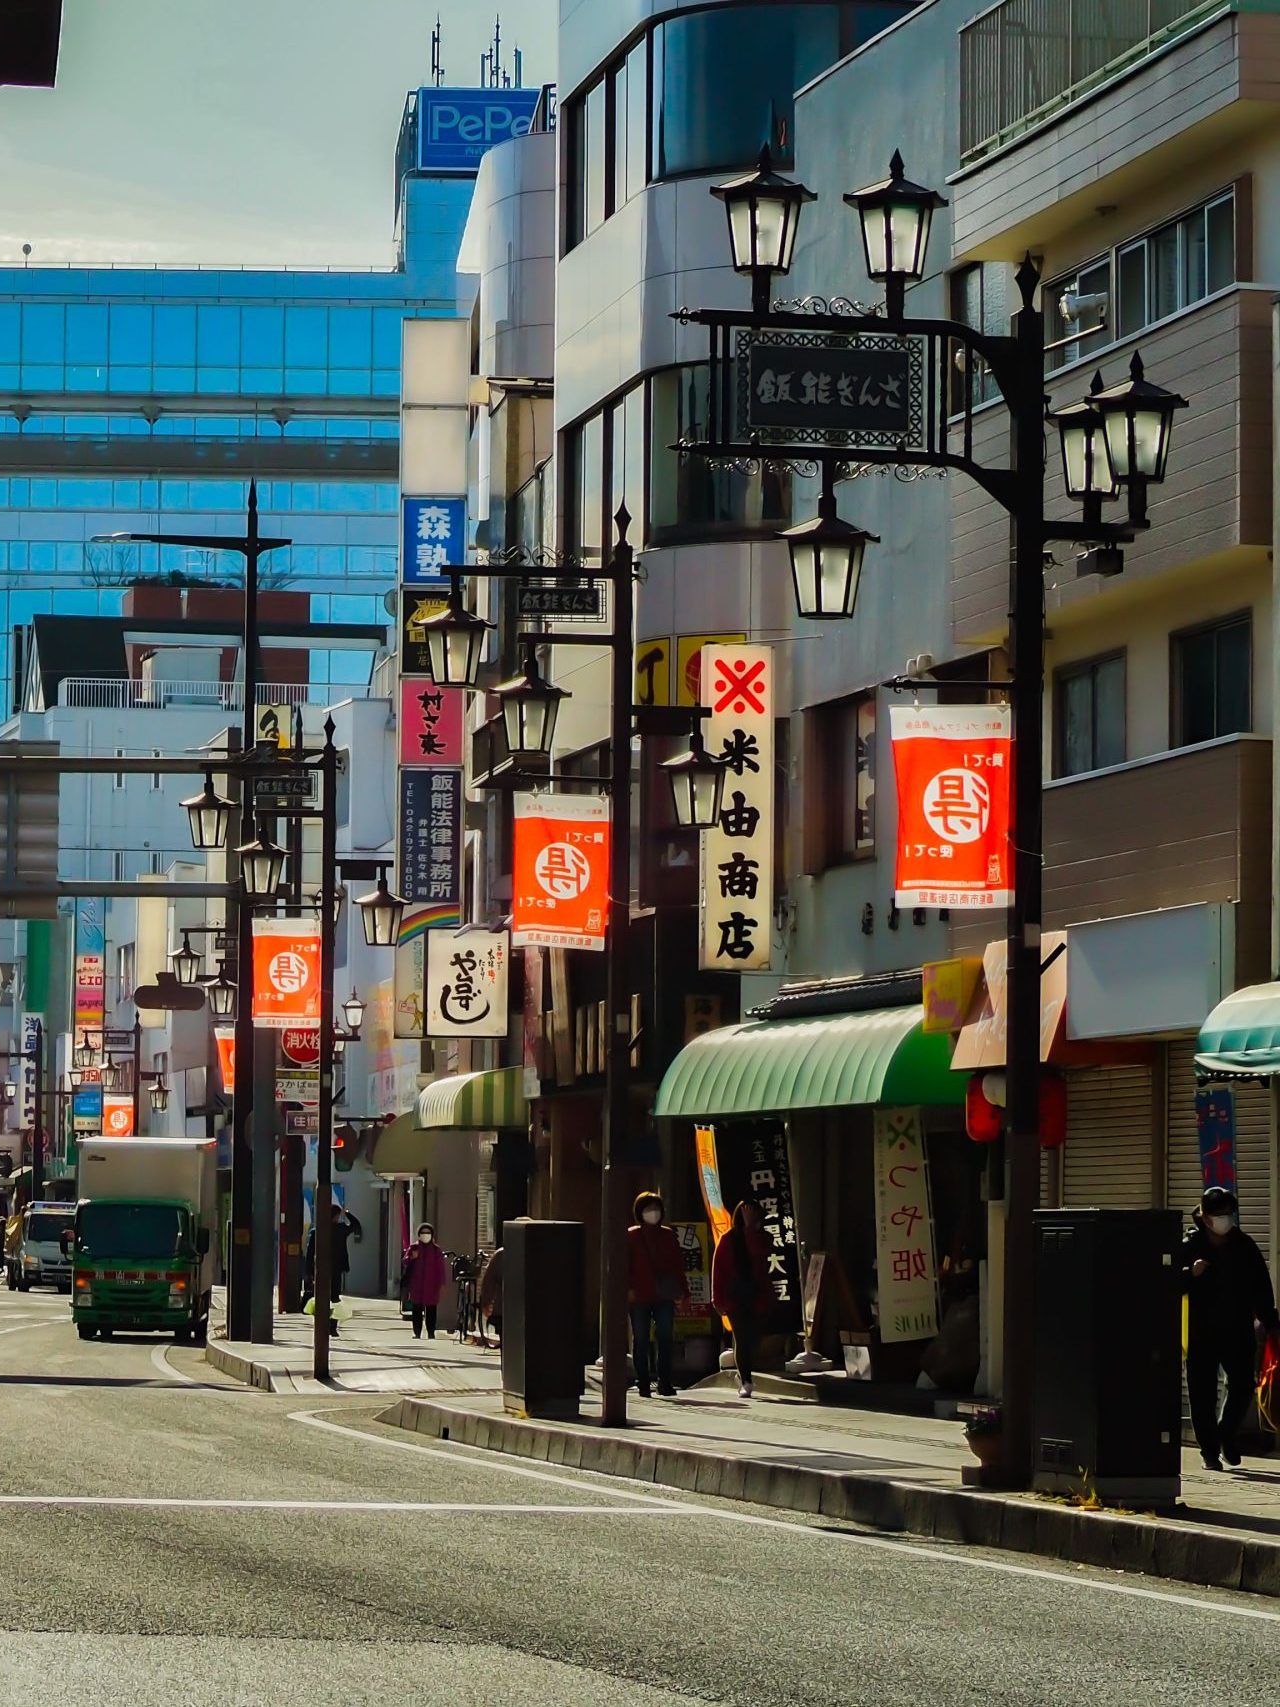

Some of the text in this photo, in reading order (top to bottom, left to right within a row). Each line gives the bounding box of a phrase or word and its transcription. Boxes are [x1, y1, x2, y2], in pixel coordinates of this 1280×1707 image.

[432, 105, 532, 142] PePe
[755, 368, 907, 410] 飯能ぎんざ
[416, 505, 452, 577] 森塾
[406, 782, 414, 805] TEL
[429, 774, 454, 898] 飯能法律事務所
[715, 728, 761, 960] 米由商店
[417, 854, 428, 881] 佐々木
